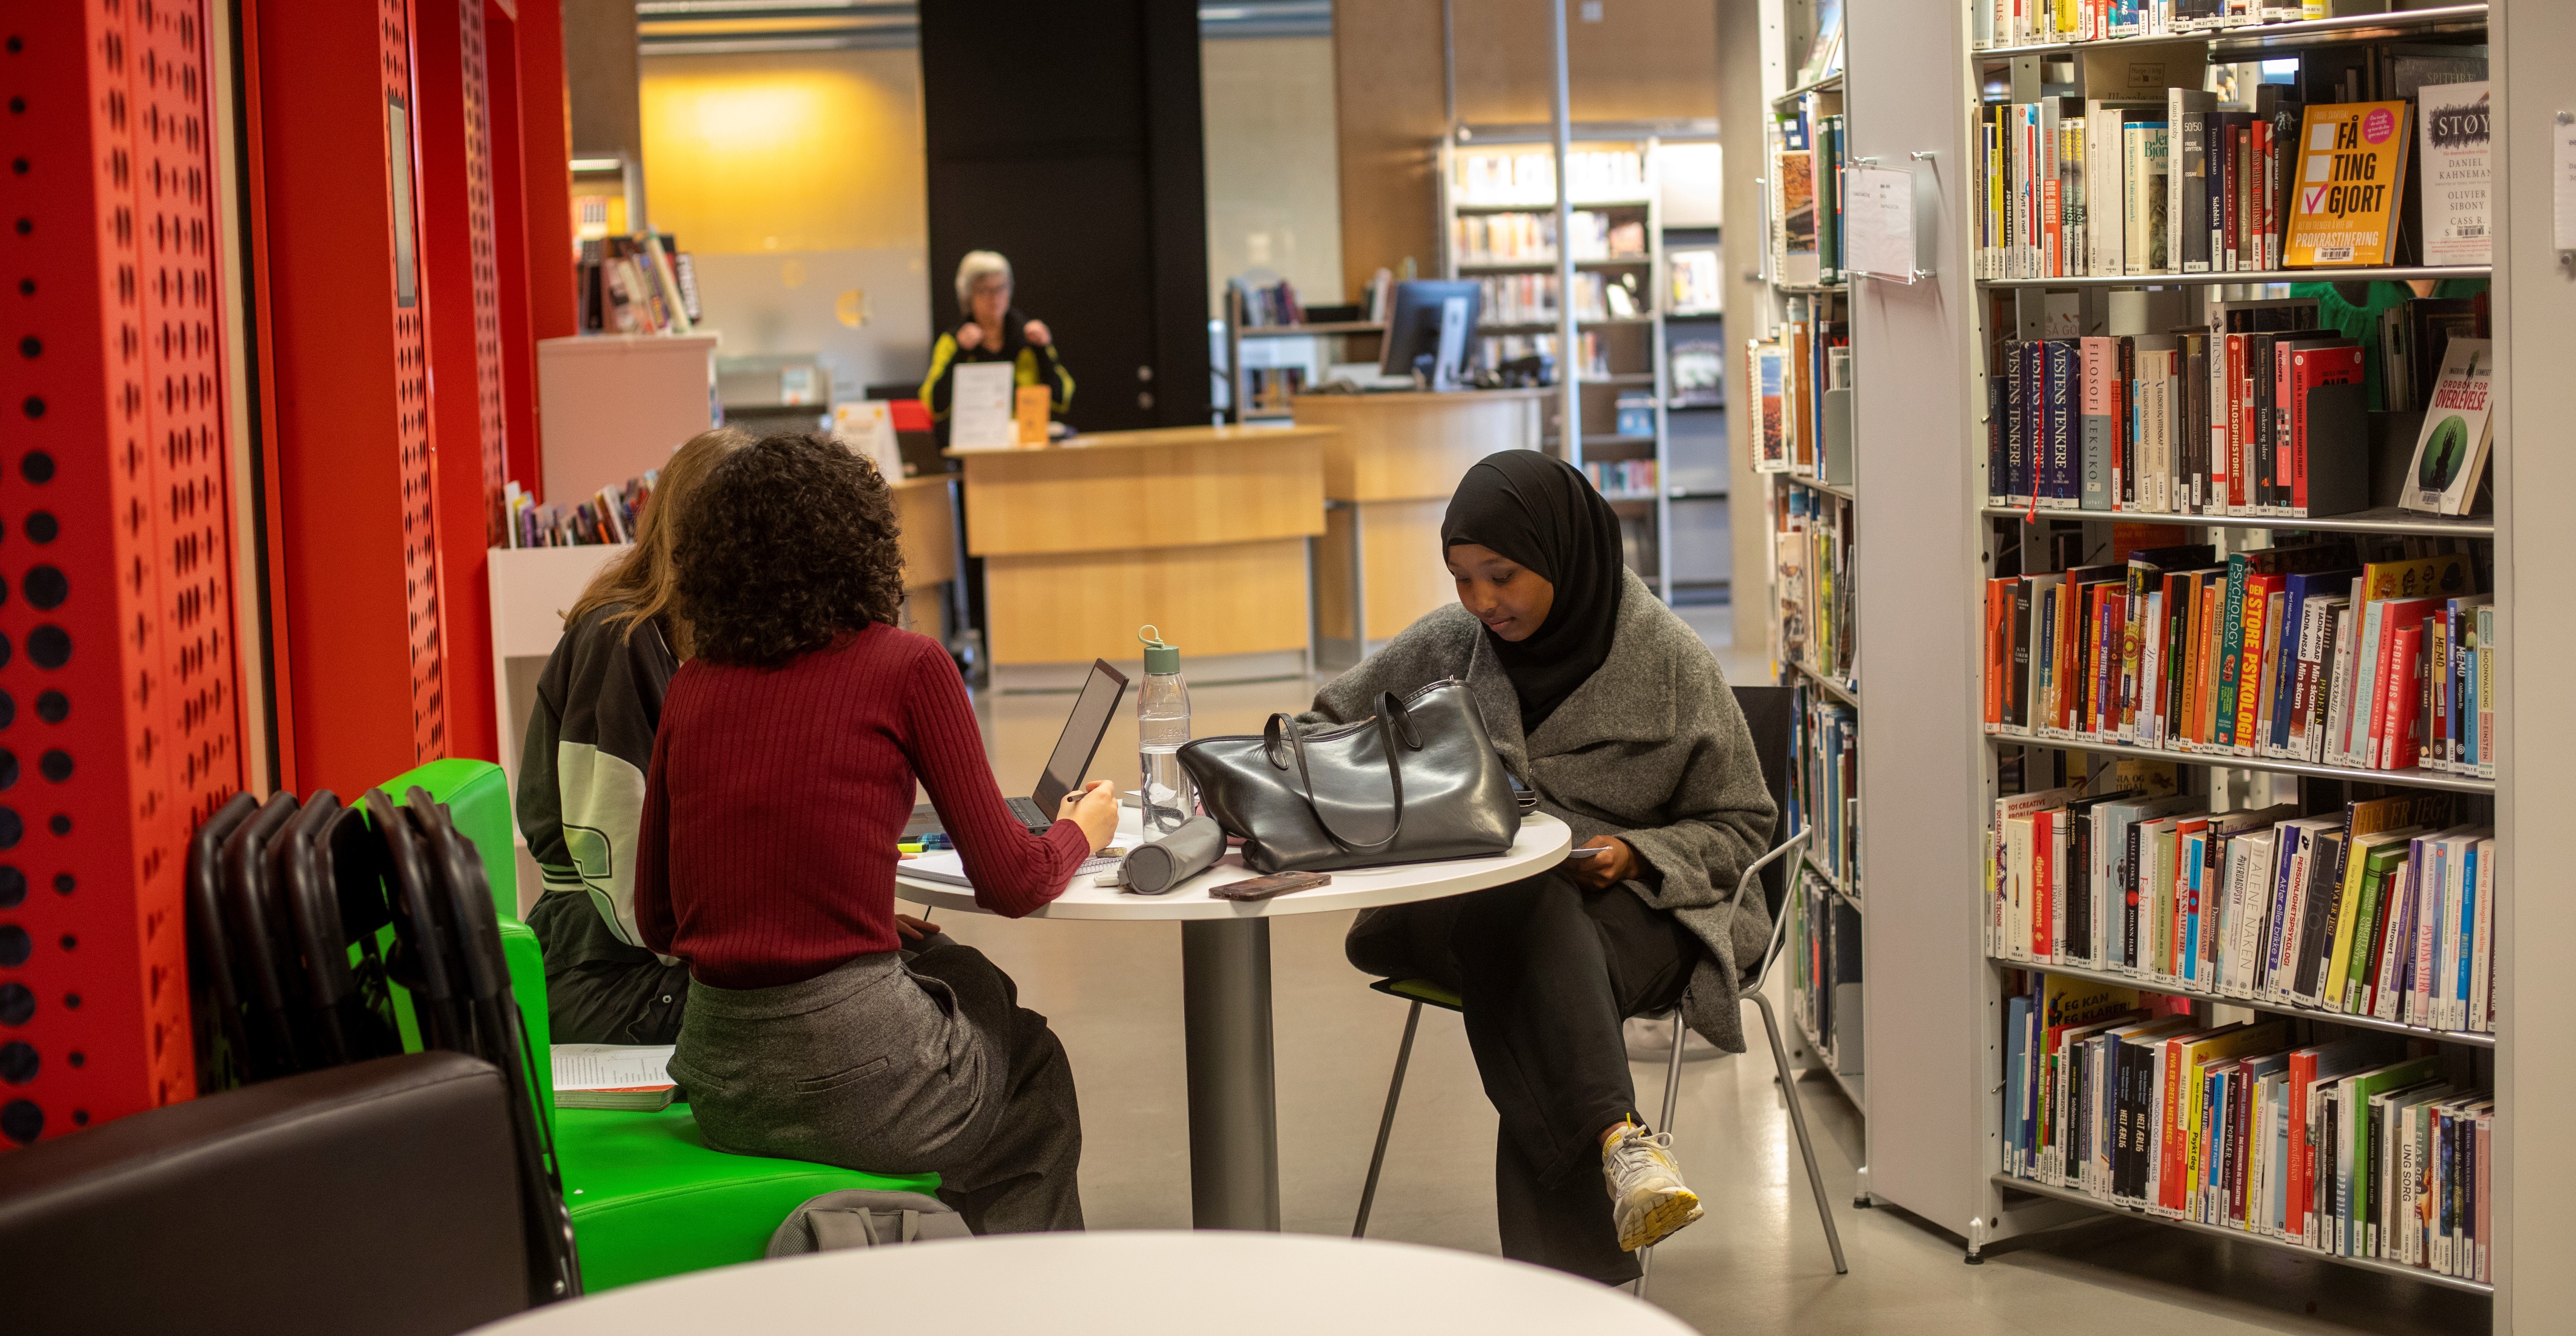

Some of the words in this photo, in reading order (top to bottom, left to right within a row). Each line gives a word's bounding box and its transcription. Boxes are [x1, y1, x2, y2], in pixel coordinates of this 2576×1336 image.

[2185, 122, 2202, 132] 50/50
[2337, 115, 2359, 150] FÅ
[2439, 115, 2490, 135] STØY
[2252, 167, 2261, 189] RAVATN
[2334, 153, 2377, 181] TING
[2449, 158, 2483, 168] DANIEL
[2046, 181, 2056, 224] BOK-NORGE
[2329, 184, 2385, 219] GJORT
[2448, 191, 2486, 200] OLIVIER
[2450, 202, 2484, 210] SIBONY
[2021, 209, 2027, 218] på
[2477, 216, 2486, 224] R.
[2295, 231, 2379, 247] PROKRASTINERING
[2009, 349, 2020, 405] VESTENS
[2055, 349, 2066, 405] VESTENS
[2089, 344, 2098, 410] FILOSOFI
[2443, 380, 2472, 389] ORDBOK
[2435, 389, 2487, 411] OVERLEVELSE
[2010, 407, 2020, 467] TENKERE
[2055, 408, 2066, 468] TENKERE
[2261, 433, 2266, 441] og
[2228, 563, 2243, 648] PSYCHOLOGY
[2249, 584, 2264, 596] DEN
[2245, 598, 2262, 650] STORE
[2392, 639, 2402, 671] PEDER
[2436, 635, 2445, 667] MEMO
[2456, 646, 2465, 677] MEMO
[2279, 657, 2287, 700] psykologihistorie
[2298, 663, 2307, 681] Min
[2237, 653, 2258, 740] PSYKOLOGI
[2295, 683, 2304, 709] skam
[2309, 685, 2318, 711] skam
[2316, 679, 2326, 714] PEDER
[2236, 739, 2250, 748] BOKA
[2035, 856, 2044, 887] digital
[2233, 855, 2247, 905] #HVERDAGSPSYK
[2248, 862, 2262, 912] ALENE
[2278, 876, 2287, 902] Aktør
[2333, 881, 2342, 900] HVA
[2284, 856, 2303, 966] PERSONLIGHETSPSYKOLOGI
[2331, 903, 2338, 915] ER
[2480, 889, 2488, 924] psykologisk
[2179, 902, 2188, 954] SMARTERE
[2210, 907, 2218, 943] Drømmer
[2272, 923, 2280, 954] brikke
[2327, 915, 2335, 935] JEG?
[2388, 921, 2397, 954] introvert
[2241, 919, 2257, 969] NAKEN
[2420, 925, 2432, 963] PSYKISK
[2418, 966, 2430, 994] STERK
[2169, 1071, 2175, 1079] ER
[2120, 1109, 2128, 1129] HELT
[2137, 1113, 2145, 1133] HELT
[2255, 1106, 2264, 1156] Stressmestrer
[2119, 1130, 2127, 1148] ÆRLIG
[2136, 1134, 2144, 1152] ÆRLIG
[2225, 1125, 2233, 1158] POPULÆR
[2403, 1144, 2412, 1168] UNG
[2403, 1171, 2411, 1202] SORG
